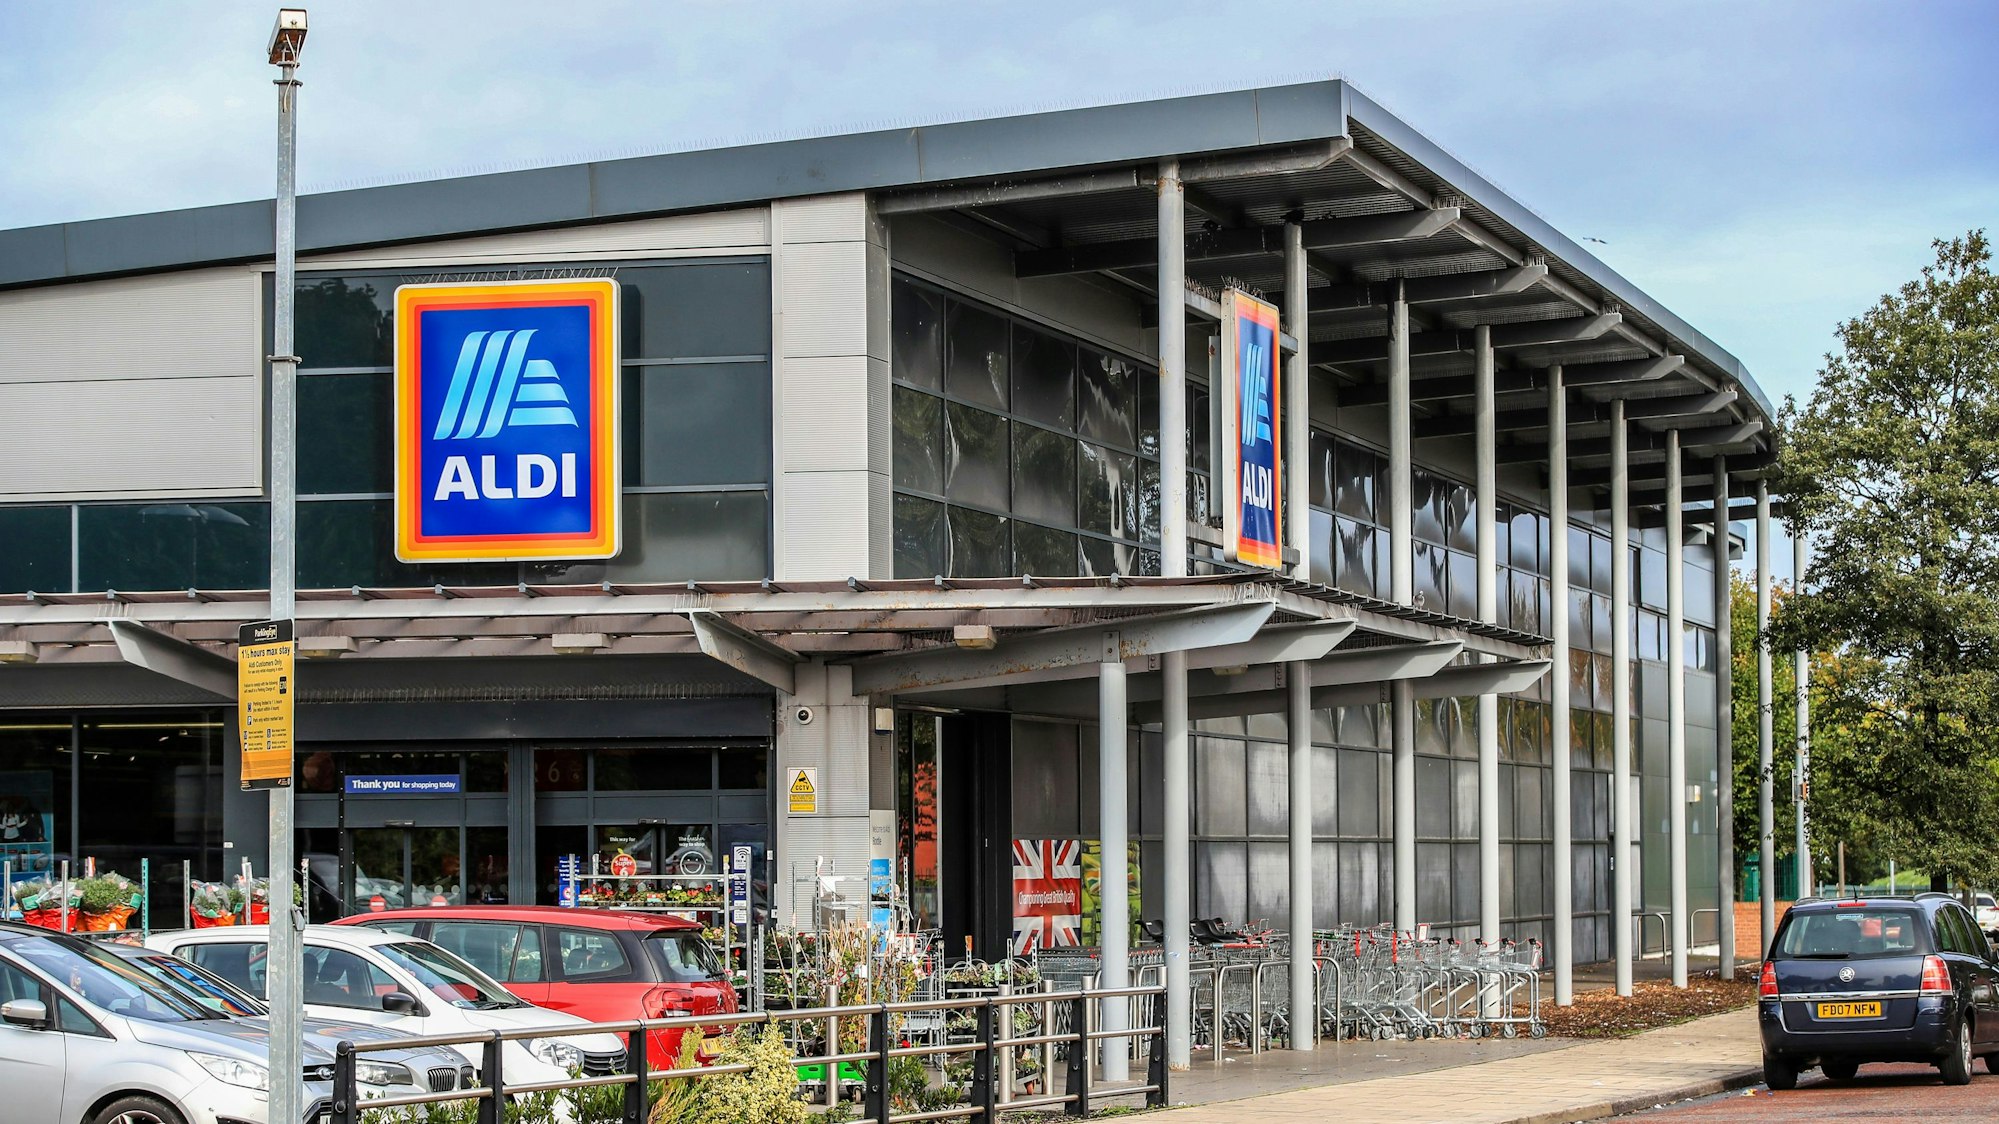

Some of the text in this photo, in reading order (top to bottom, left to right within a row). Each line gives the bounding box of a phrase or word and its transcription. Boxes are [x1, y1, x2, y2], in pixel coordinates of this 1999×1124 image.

[434, 453, 577, 501] ALDI
[1242, 461, 1273, 511] ALDI
[250, 649, 265, 657] hours
[266, 648, 277, 656] max
[279, 646, 290, 656] stay
[548, 761, 560, 782] 6
[352, 780, 381, 789] Thank
[383, 781, 400, 790] you
[411, 782, 439, 790] shopping
[439, 782, 456, 790] today
[1019, 890, 1075, 907] Championing Great British Quality
[1822, 1004, 1875, 1015] FD07 NFM
